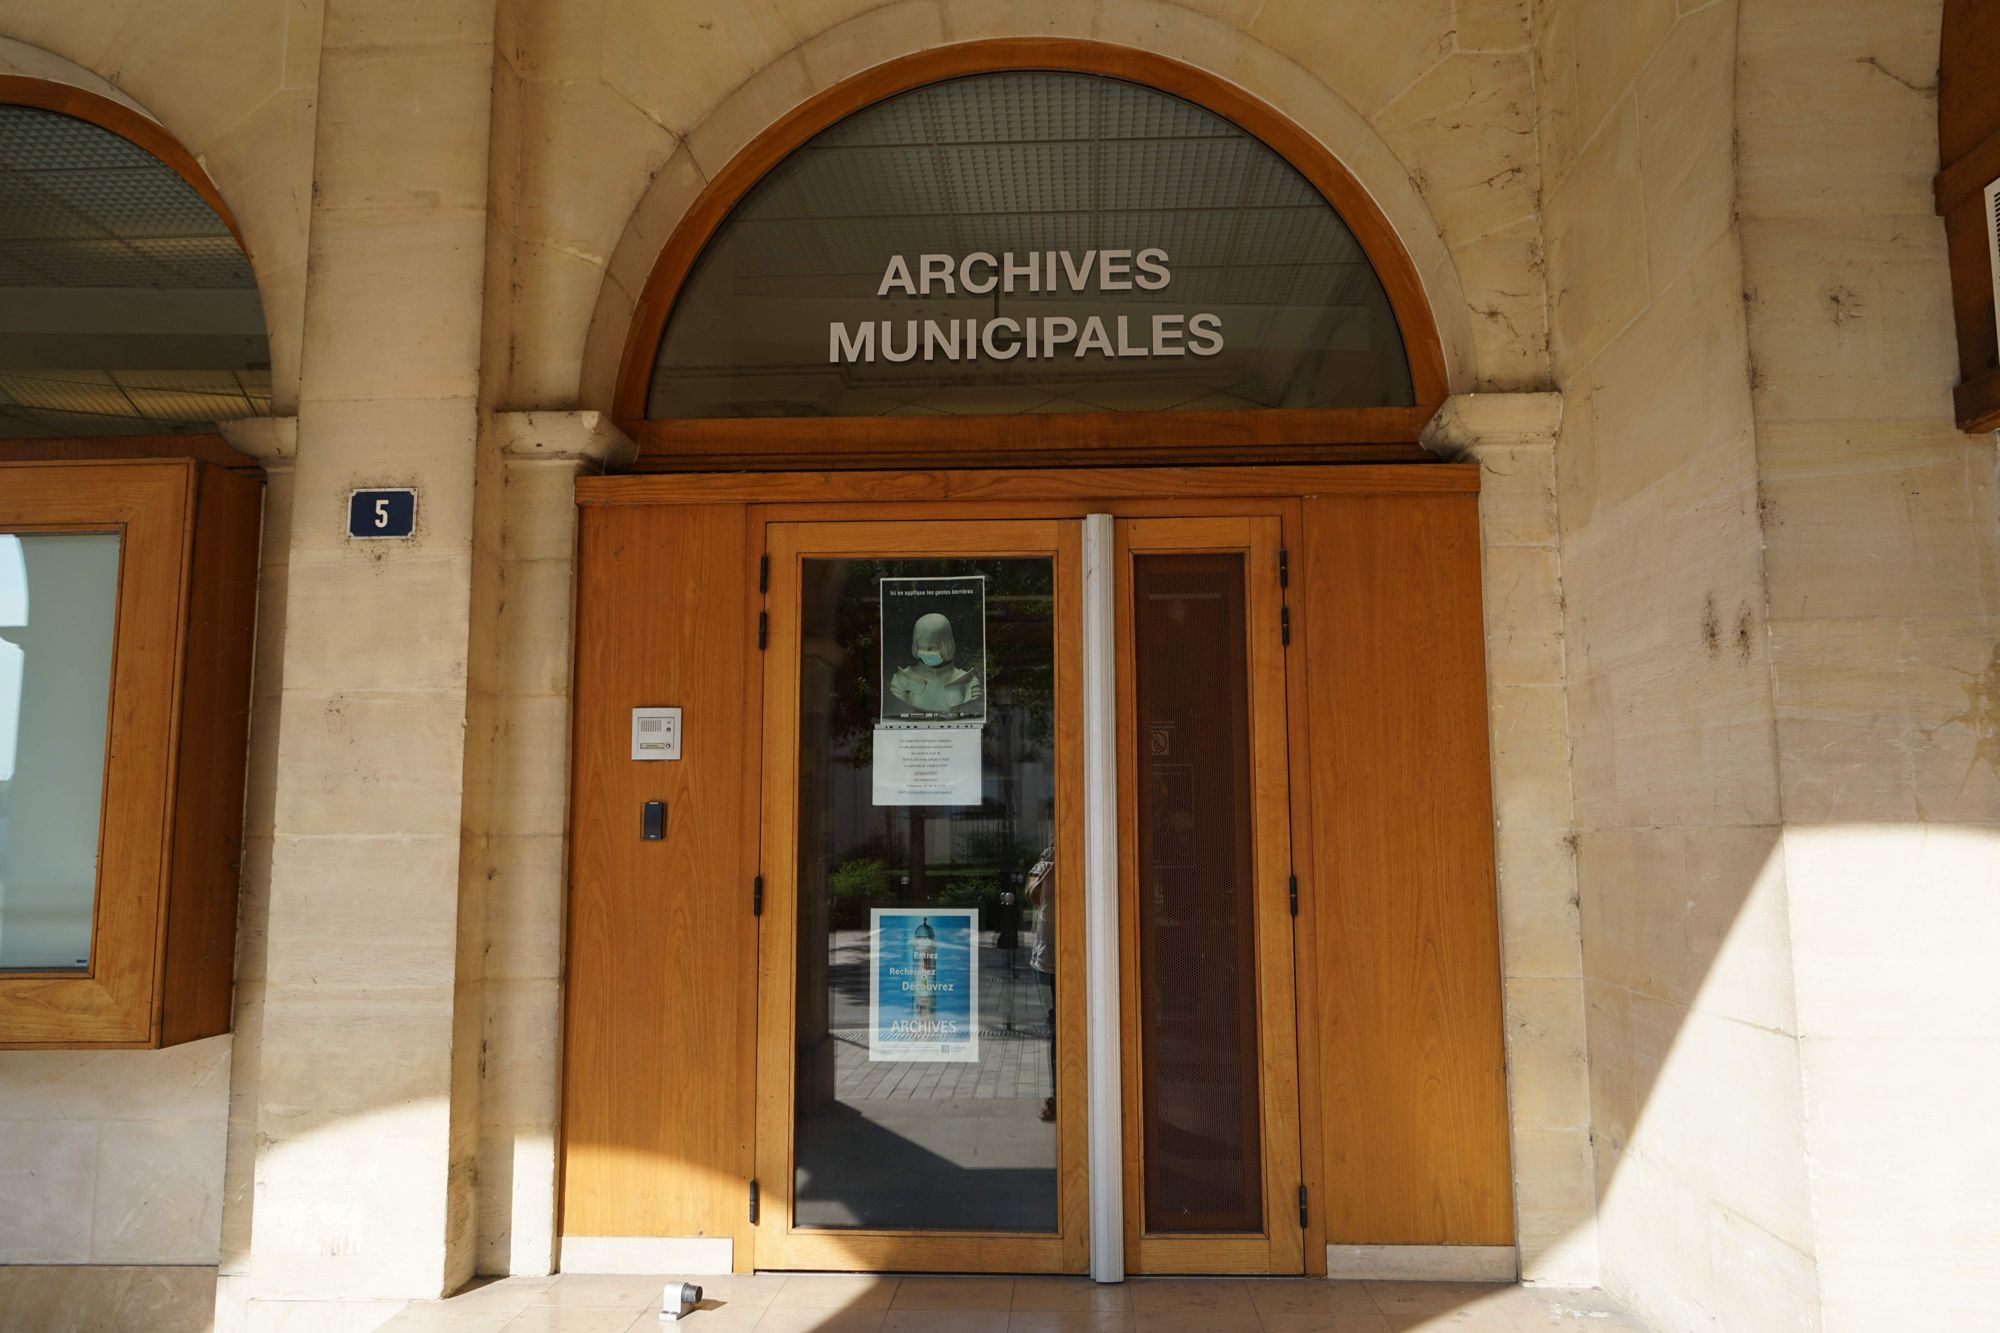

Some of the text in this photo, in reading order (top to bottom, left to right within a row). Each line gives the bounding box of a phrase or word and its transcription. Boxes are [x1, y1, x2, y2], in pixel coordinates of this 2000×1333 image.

[877, 247, 1171, 295] ARCHIVES
[829, 313, 1224, 363] MUNICIPALES
[374, 499, 389, 528] 5
[913, 951, 939, 960] Entrez
[889, 967, 936, 975] Recherchez
[902, 981, 954, 991] Découvrez
[890, 1019, 957, 1033] ARCHIVES
